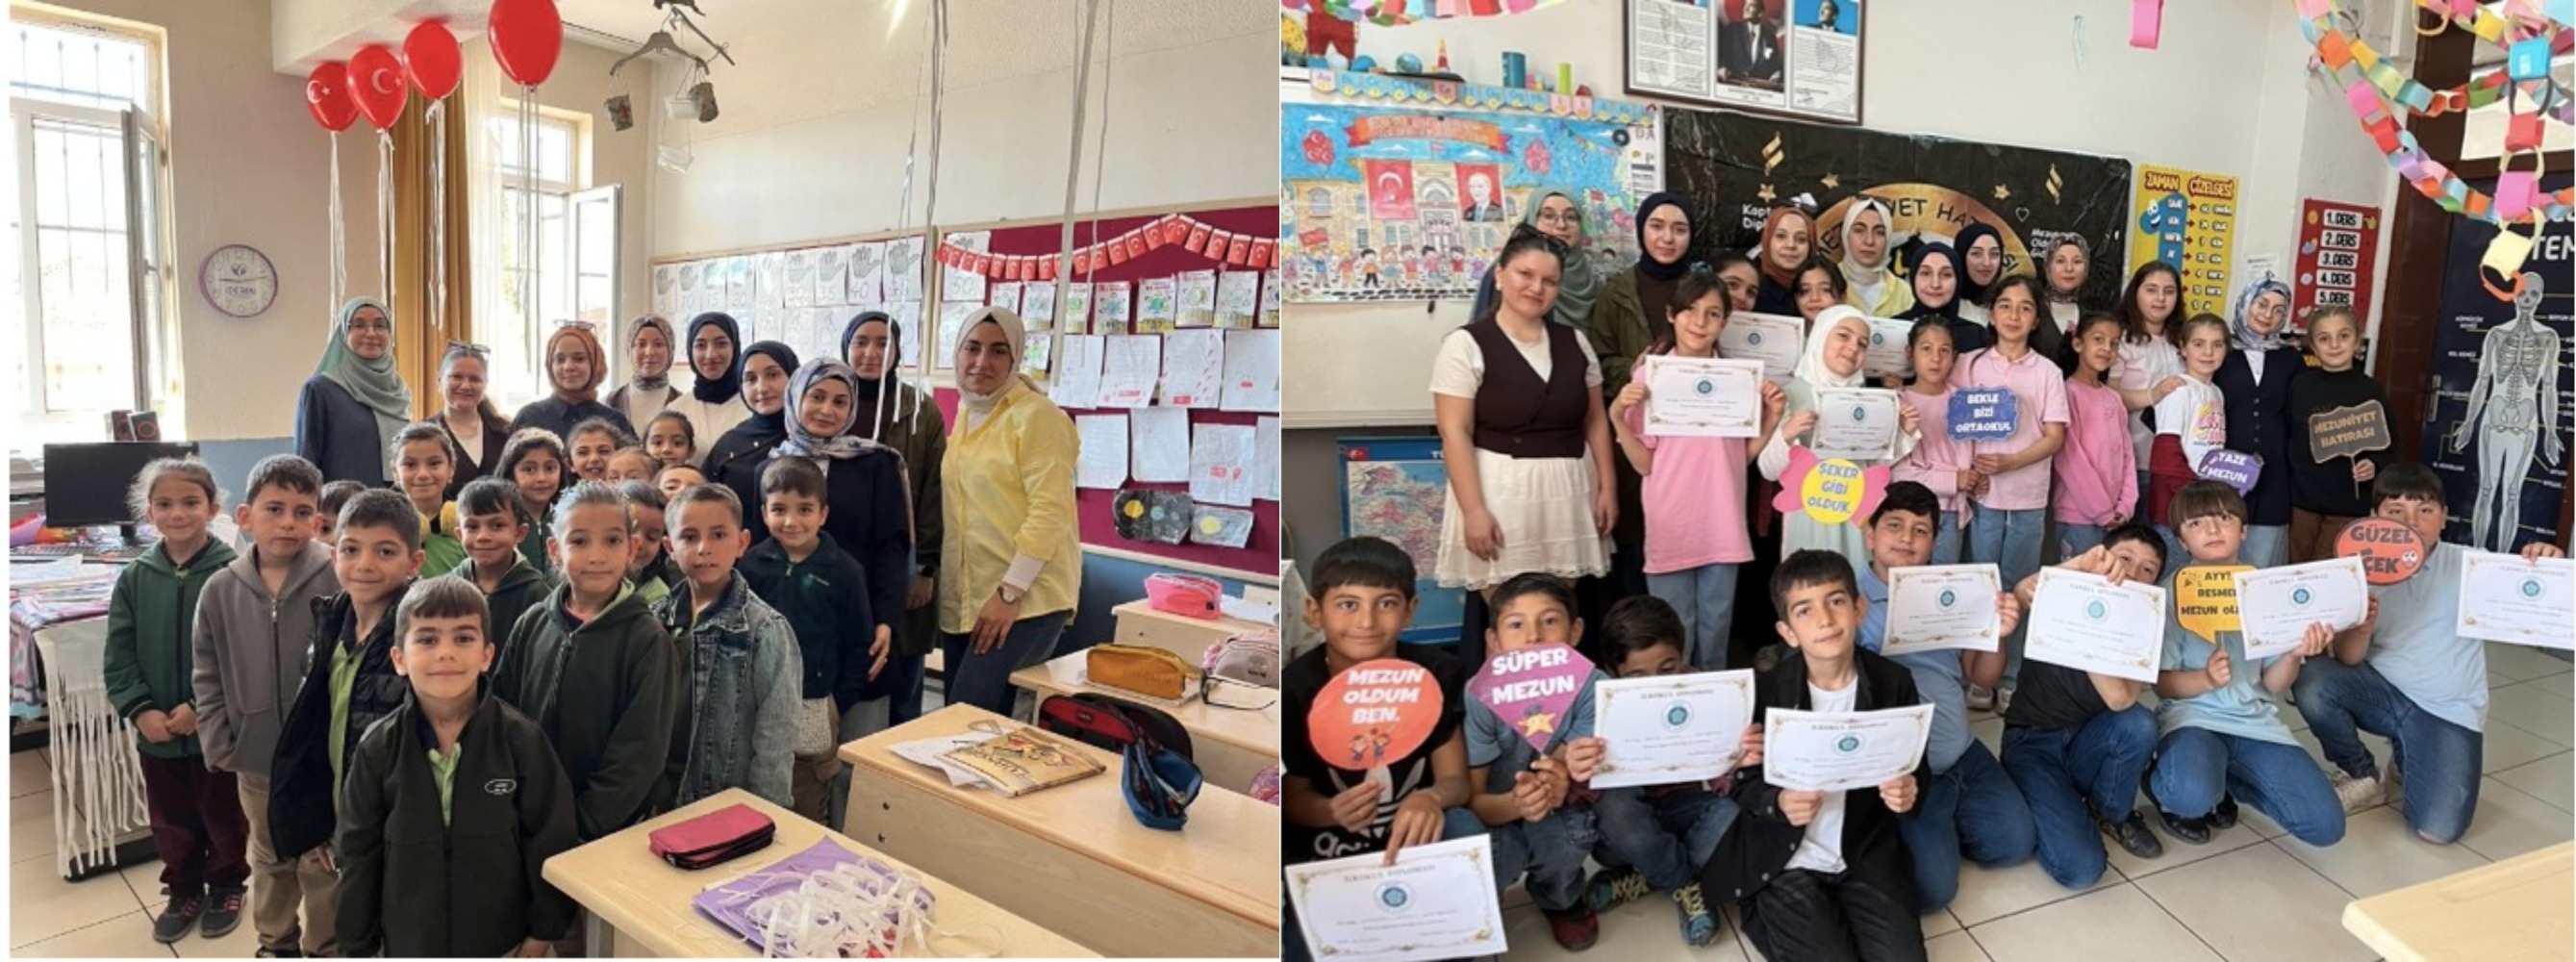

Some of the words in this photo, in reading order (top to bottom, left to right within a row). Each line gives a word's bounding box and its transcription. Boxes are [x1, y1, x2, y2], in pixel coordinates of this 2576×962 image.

[1956, 421, 2011, 433] ORTAOKUL
[2314, 411, 2377, 435] MEZUNİYET
[2320, 426, 2375, 447] HATIRASI
[2351, 523, 2414, 544] GÜZEL
[2182, 605, 2218, 616] MEZUN
[1492, 646, 1568, 676] SÜPER
[1347, 668, 1424, 685] MEZUN
[1343, 687, 1421, 704] OLDUM
[1492, 674, 1575, 705] MEZUN
[1351, 706, 1401, 724] BEN.
